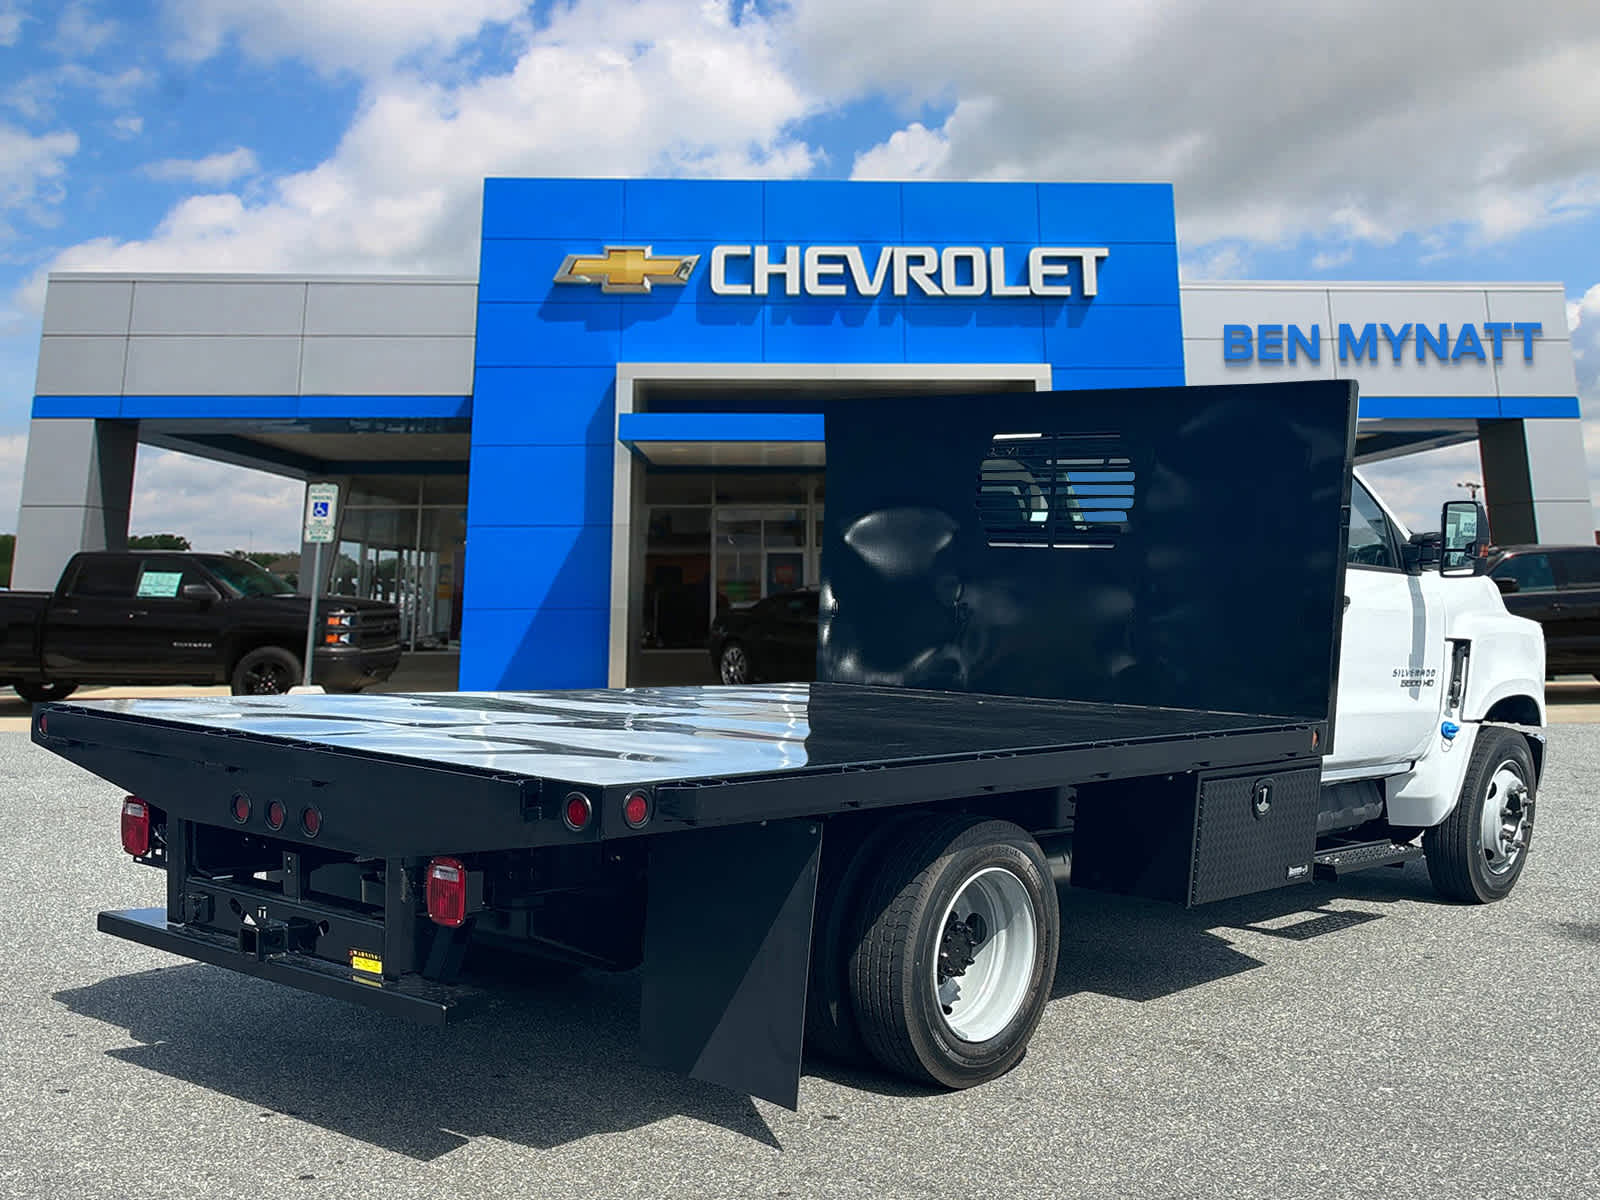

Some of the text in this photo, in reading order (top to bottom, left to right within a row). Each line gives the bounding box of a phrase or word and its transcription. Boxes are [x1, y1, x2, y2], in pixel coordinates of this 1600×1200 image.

[710, 245, 1110, 297] CHEVROLET
[1223, 321, 1543, 363] BEN MYNATT
[1392, 668, 1436, 678] SILVERADO
[1422, 679, 1435, 688] HD
